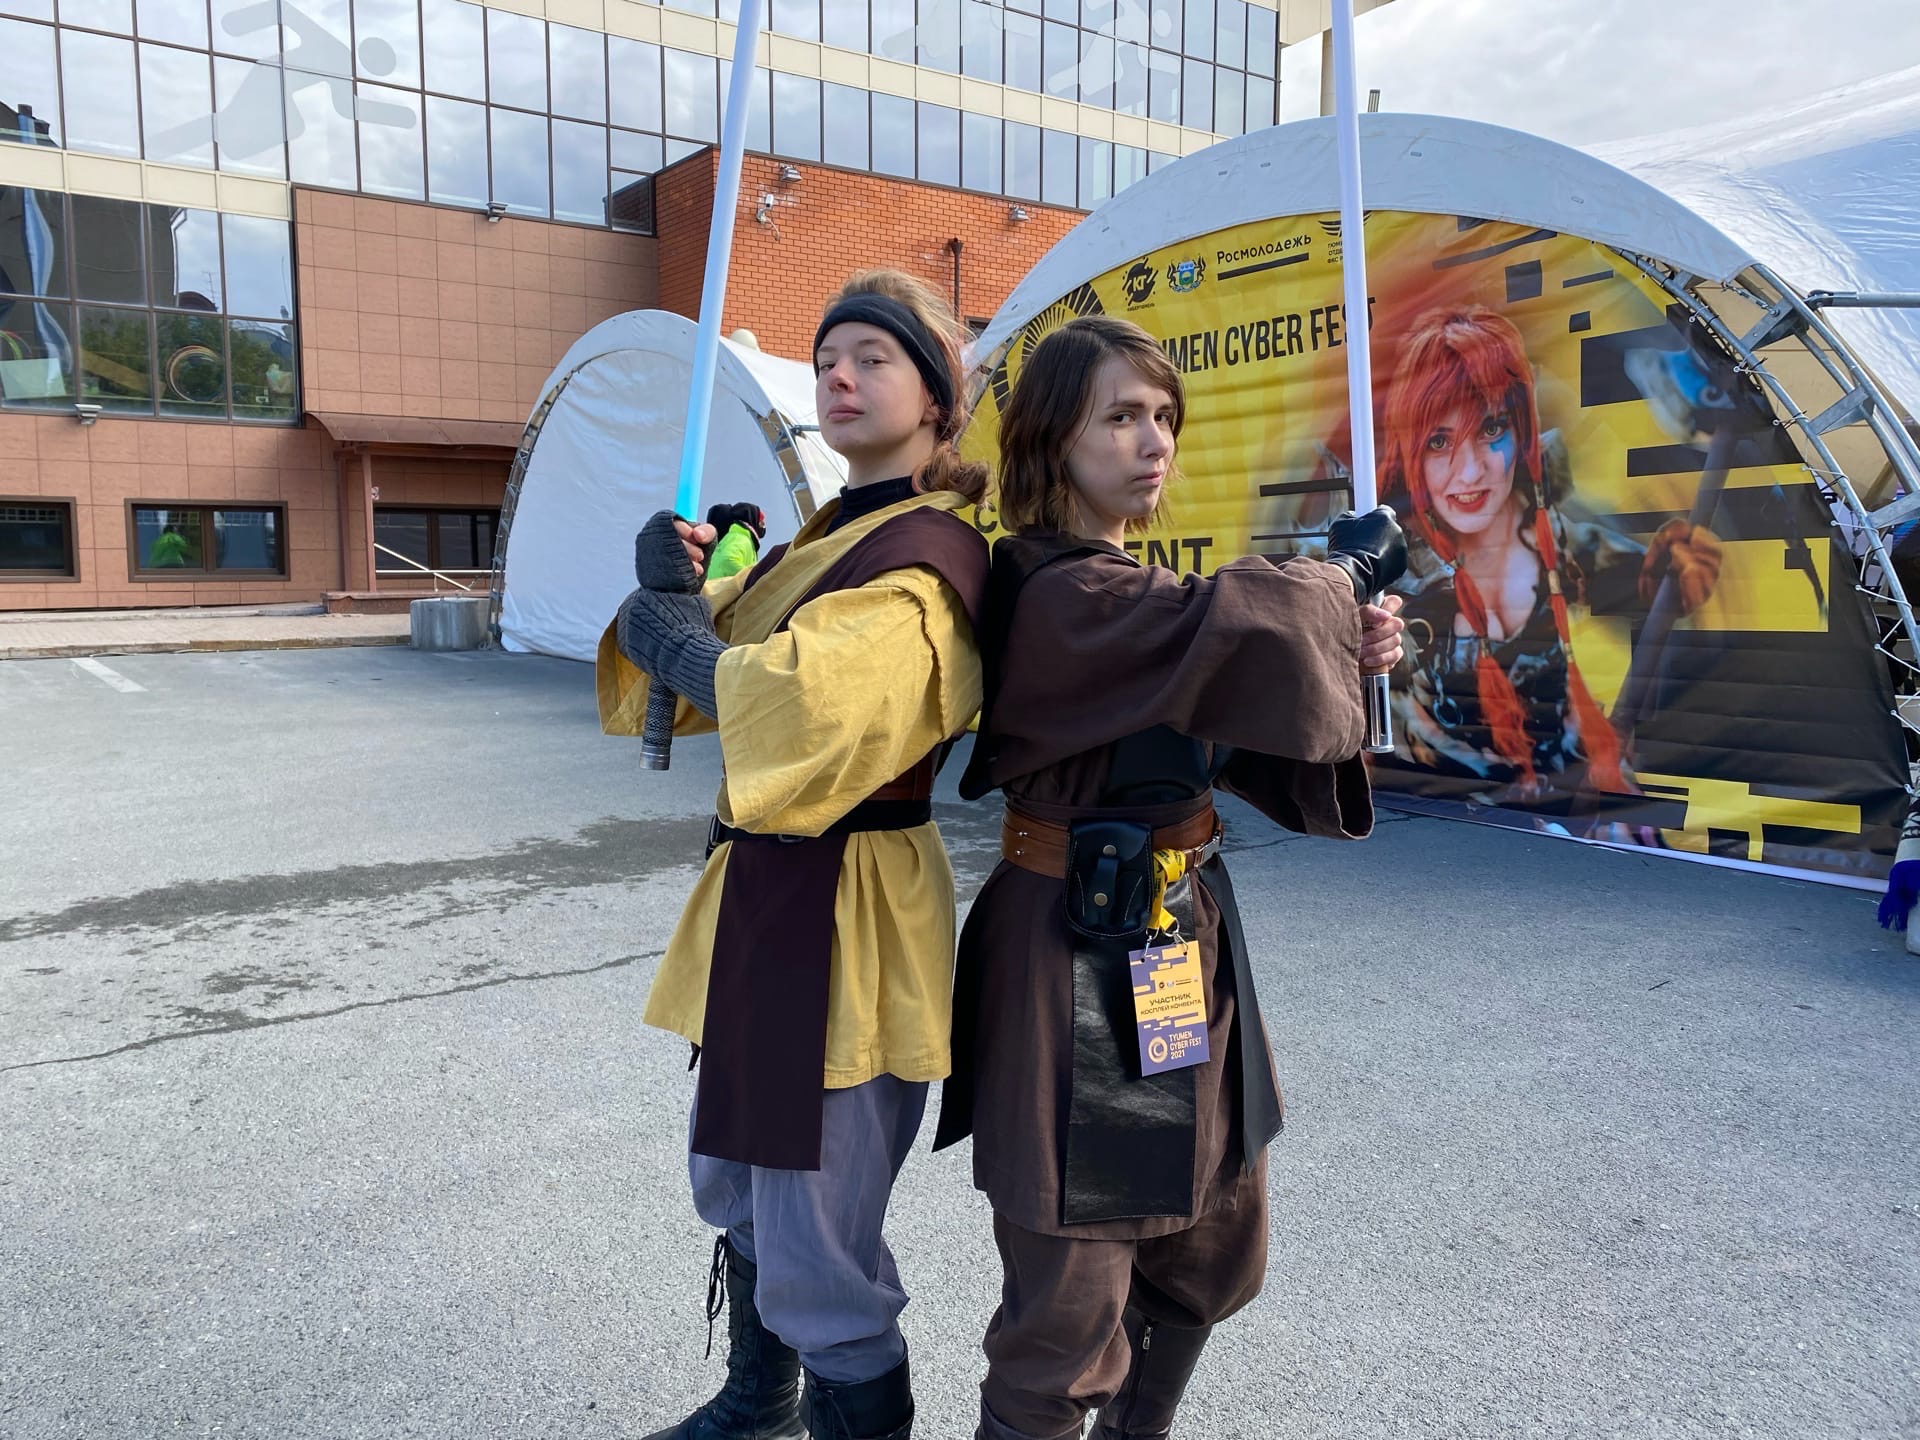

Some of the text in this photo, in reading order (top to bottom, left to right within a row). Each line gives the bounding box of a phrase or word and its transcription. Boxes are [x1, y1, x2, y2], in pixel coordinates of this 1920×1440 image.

[1216, 234, 1312, 265] Росмолодежь
[1224, 313, 1304, 367] CYBER
[1310, 296, 1376, 350] FE
[1149, 992, 1192, 1006] УЧАСТНИК
[1140, 1004, 1170, 1016] КОСПЛЕЙ
[1168, 1030, 1193, 1043] TYUMEN
[1169, 1036, 1202, 1051] CYBER FEST
[1170, 1049, 1185, 1060] 2021
